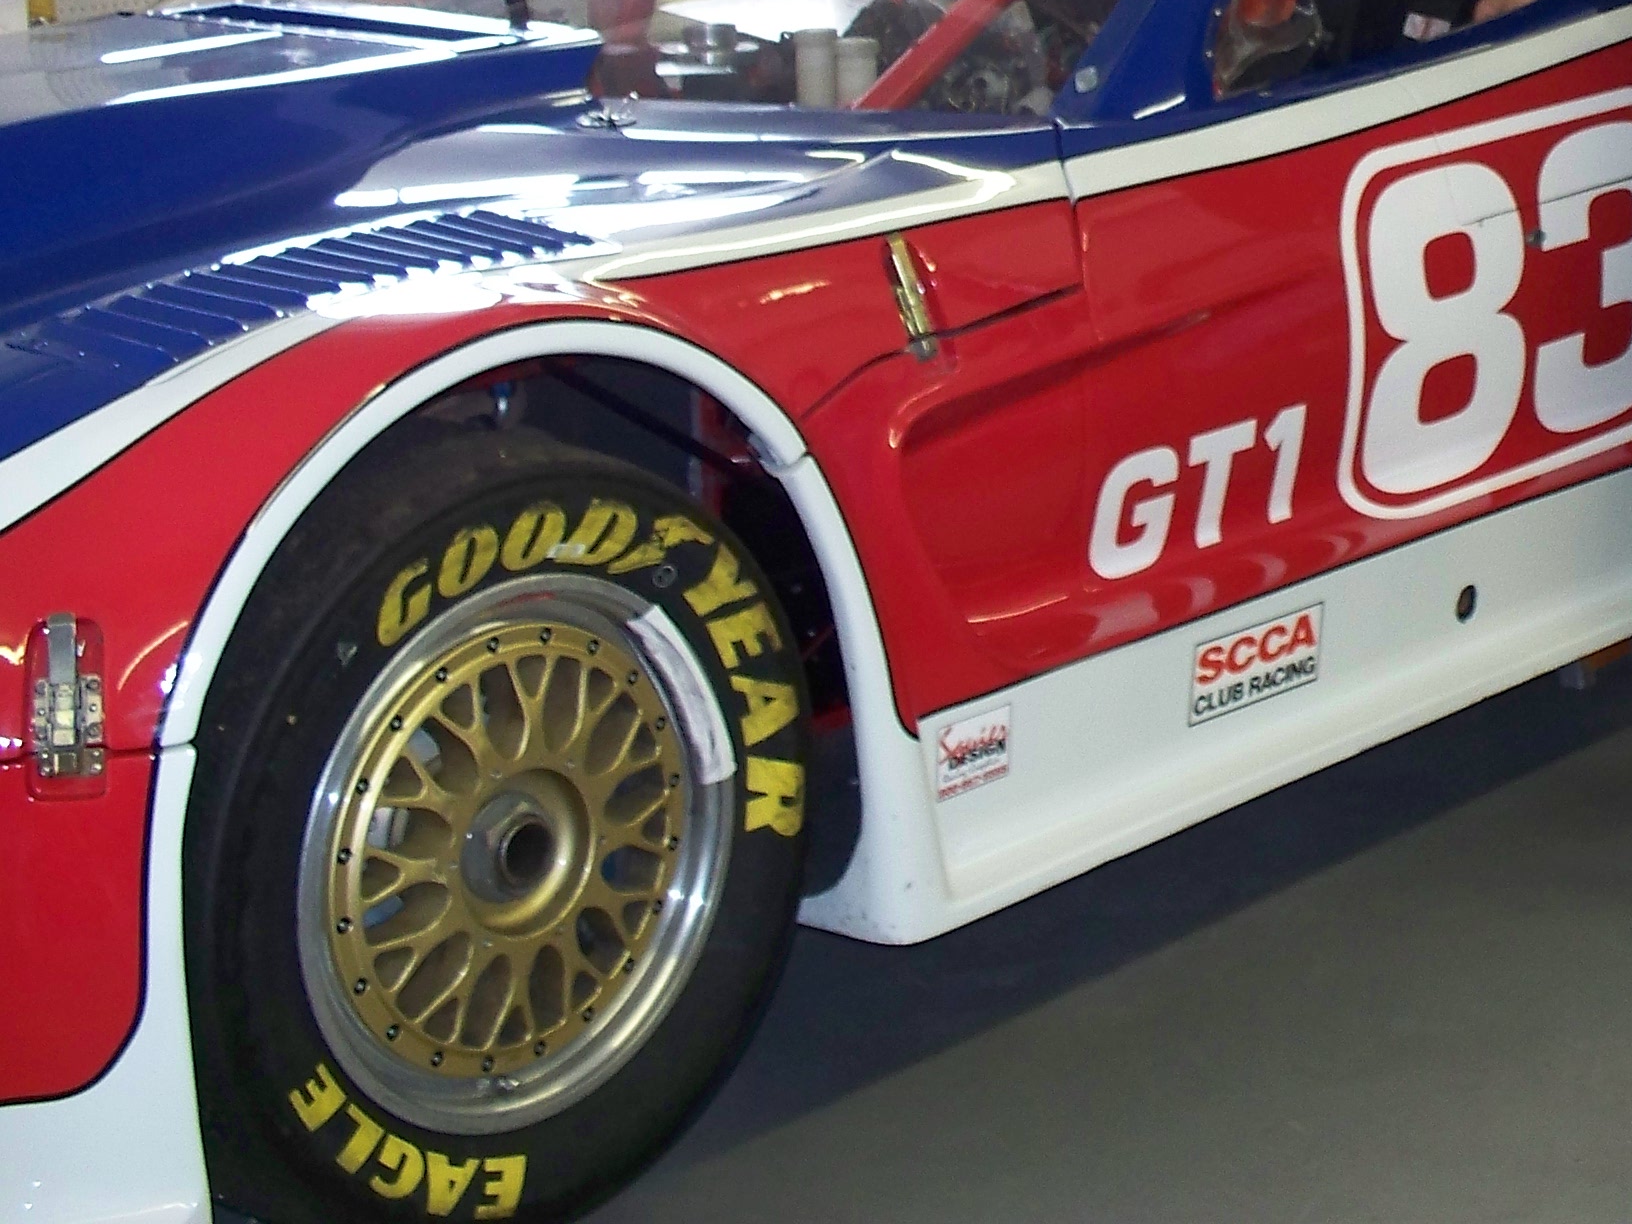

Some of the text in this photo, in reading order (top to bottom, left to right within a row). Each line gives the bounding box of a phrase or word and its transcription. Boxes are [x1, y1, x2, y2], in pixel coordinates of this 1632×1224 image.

[1088, 404, 1307, 580] GT1
[1194, 656, 1315, 716] CLUB RACING
[1196, 614, 1317, 685] SCCA
[288, 1063, 527, 1220] EAGLE
